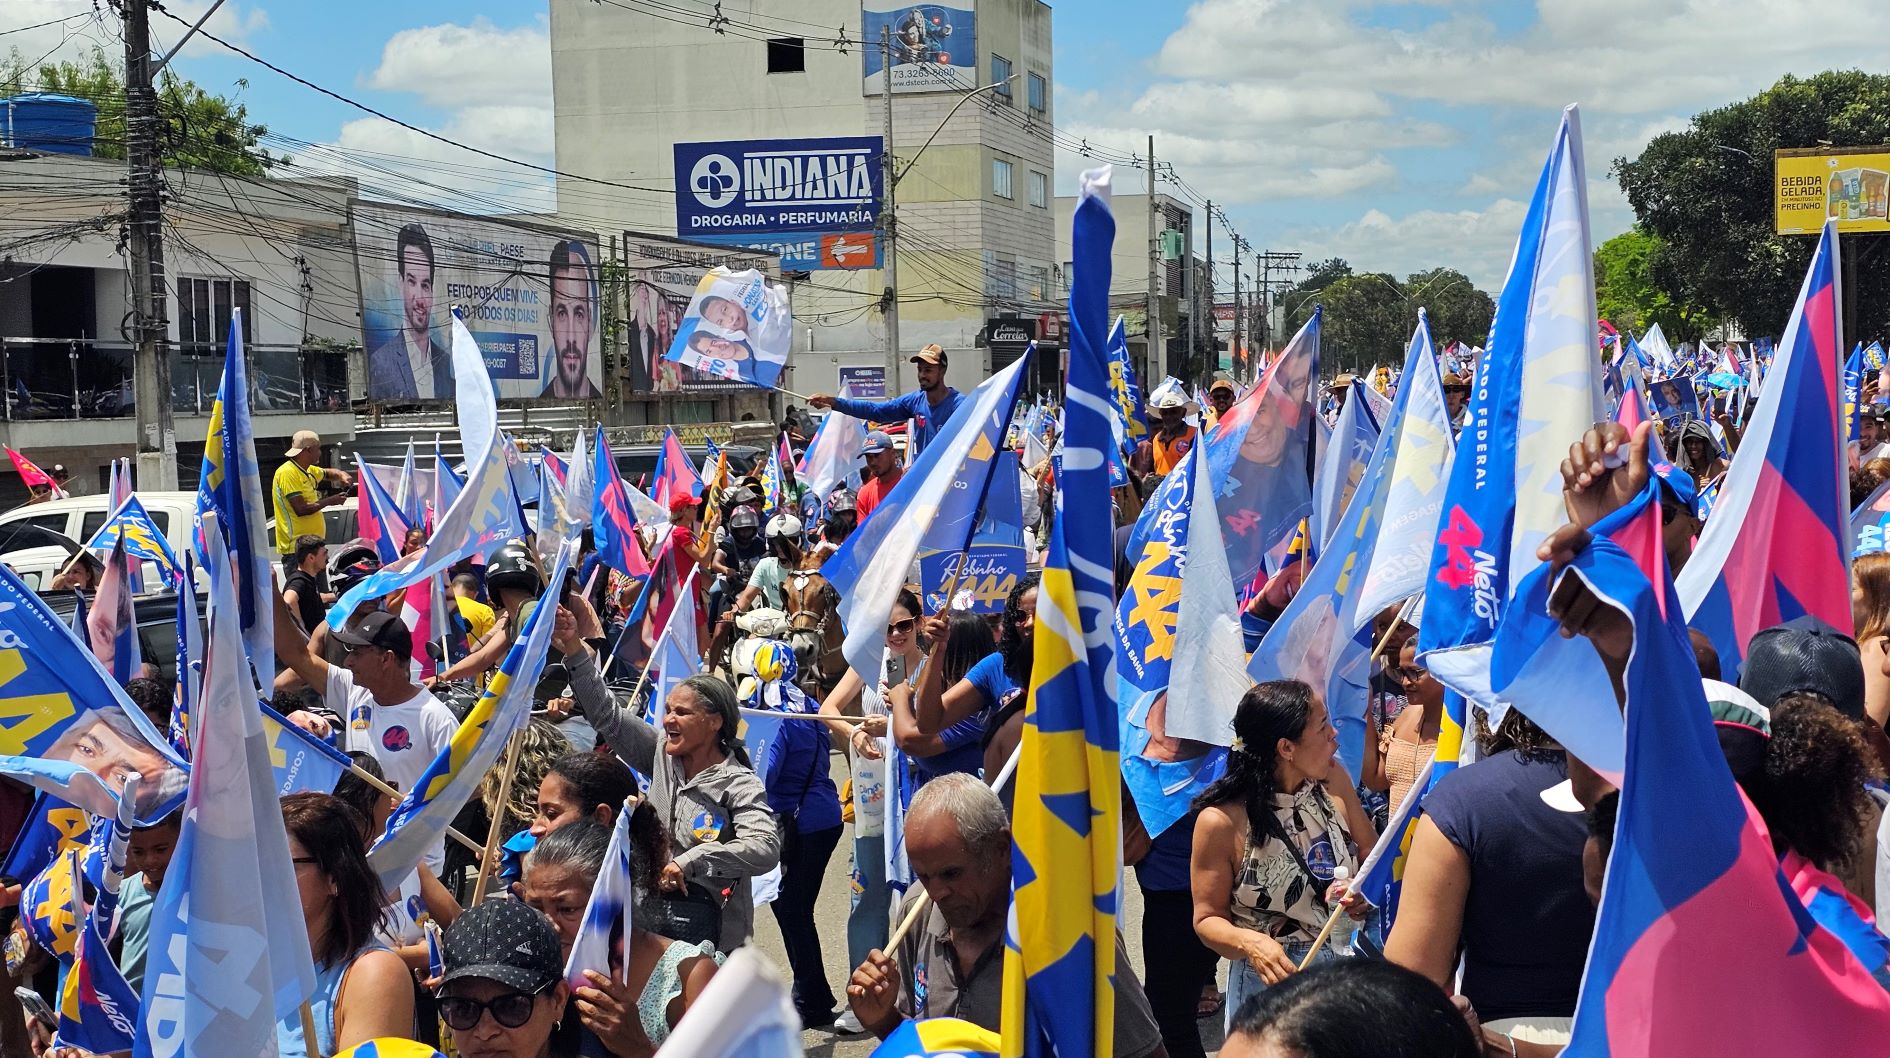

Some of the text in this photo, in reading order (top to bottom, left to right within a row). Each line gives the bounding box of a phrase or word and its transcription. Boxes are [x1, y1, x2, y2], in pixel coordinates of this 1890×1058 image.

[744, 156, 872, 200] INDIANA
[1781, 176, 1822, 187] BEBIDA
[691, 210, 873, 228] DROGARIA PERFUMARIA
[500, 243, 525, 258] PAESE
[447, 283, 539, 305] FEITO POR QUEM VIVE
[448, 303, 539, 324] ISO TODOS OS DIAS!
[993, 328, 1029, 341] Correias
[1475, 408, 1488, 490] FEDERAL
[940, 552, 1008, 582] Robinho
[1473, 549, 1501, 630] Neto
[15, 592, 55, 632] FEDERAL
[1121, 635, 1131, 651] DA
[1127, 649, 1145, 680] BAHIA
